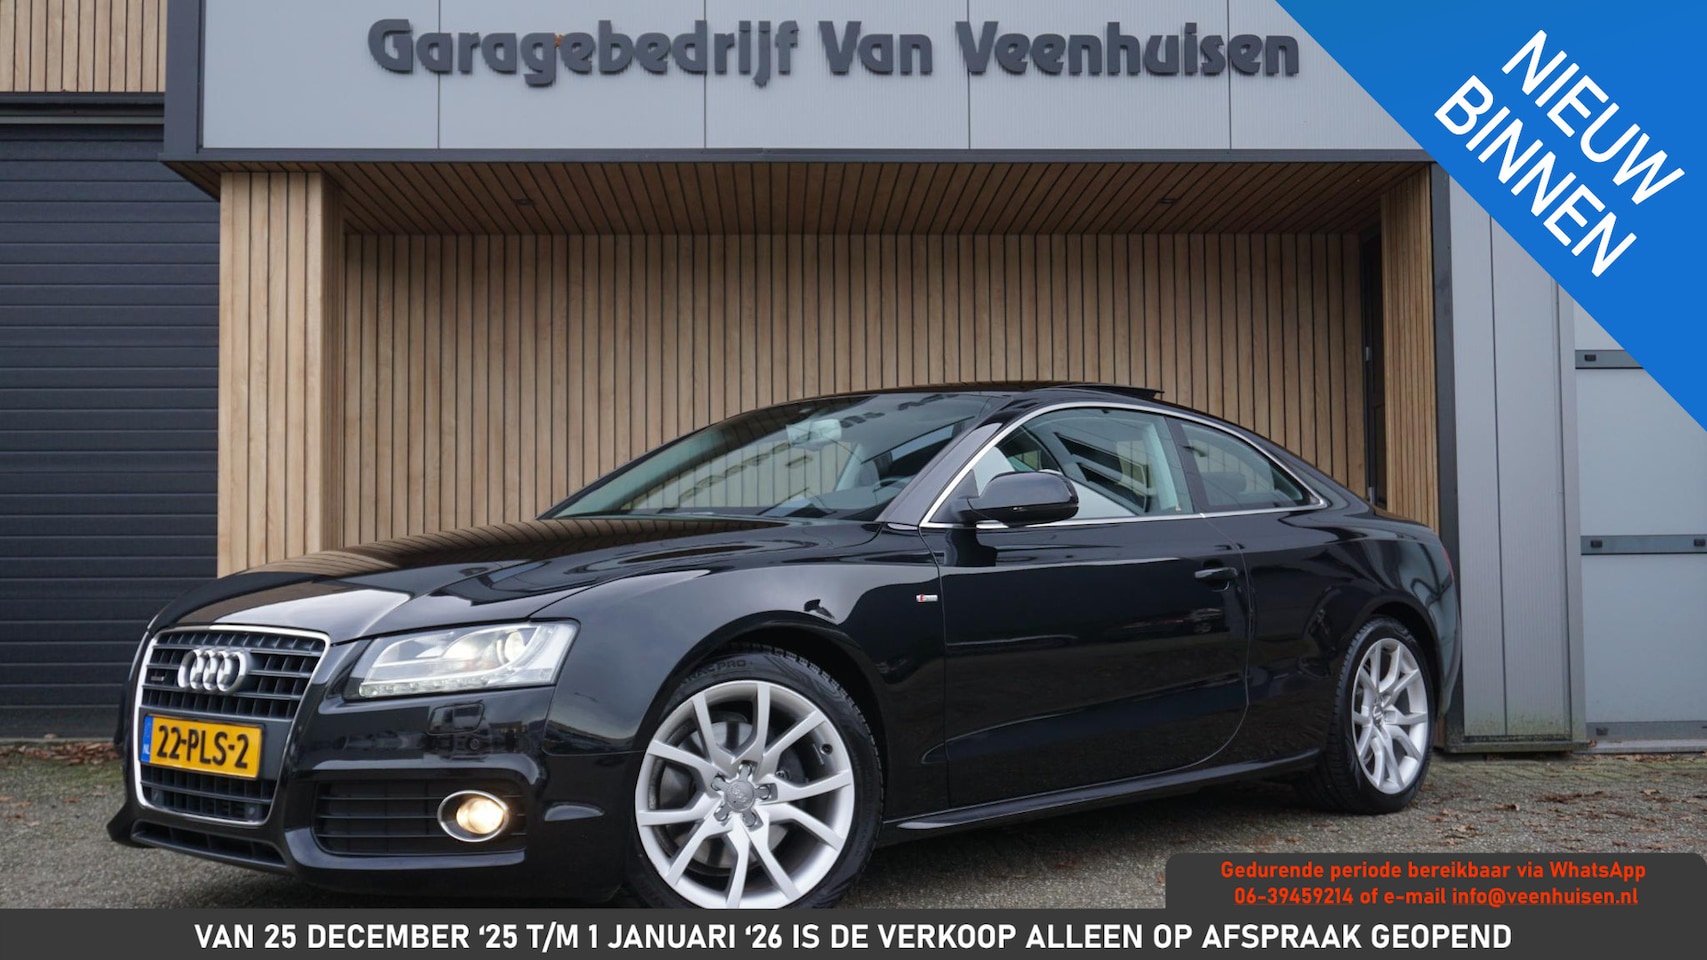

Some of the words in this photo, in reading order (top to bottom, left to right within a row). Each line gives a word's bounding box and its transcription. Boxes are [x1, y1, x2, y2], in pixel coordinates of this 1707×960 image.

[368, 18, 799, 87] Garagebedrijf
[818, 20, 933, 76] Van
[955, 20, 1300, 76] Veenhuisen
[713, 659, 747, 671] PRO
[157, 726, 249, 768] 22-PLS-2
